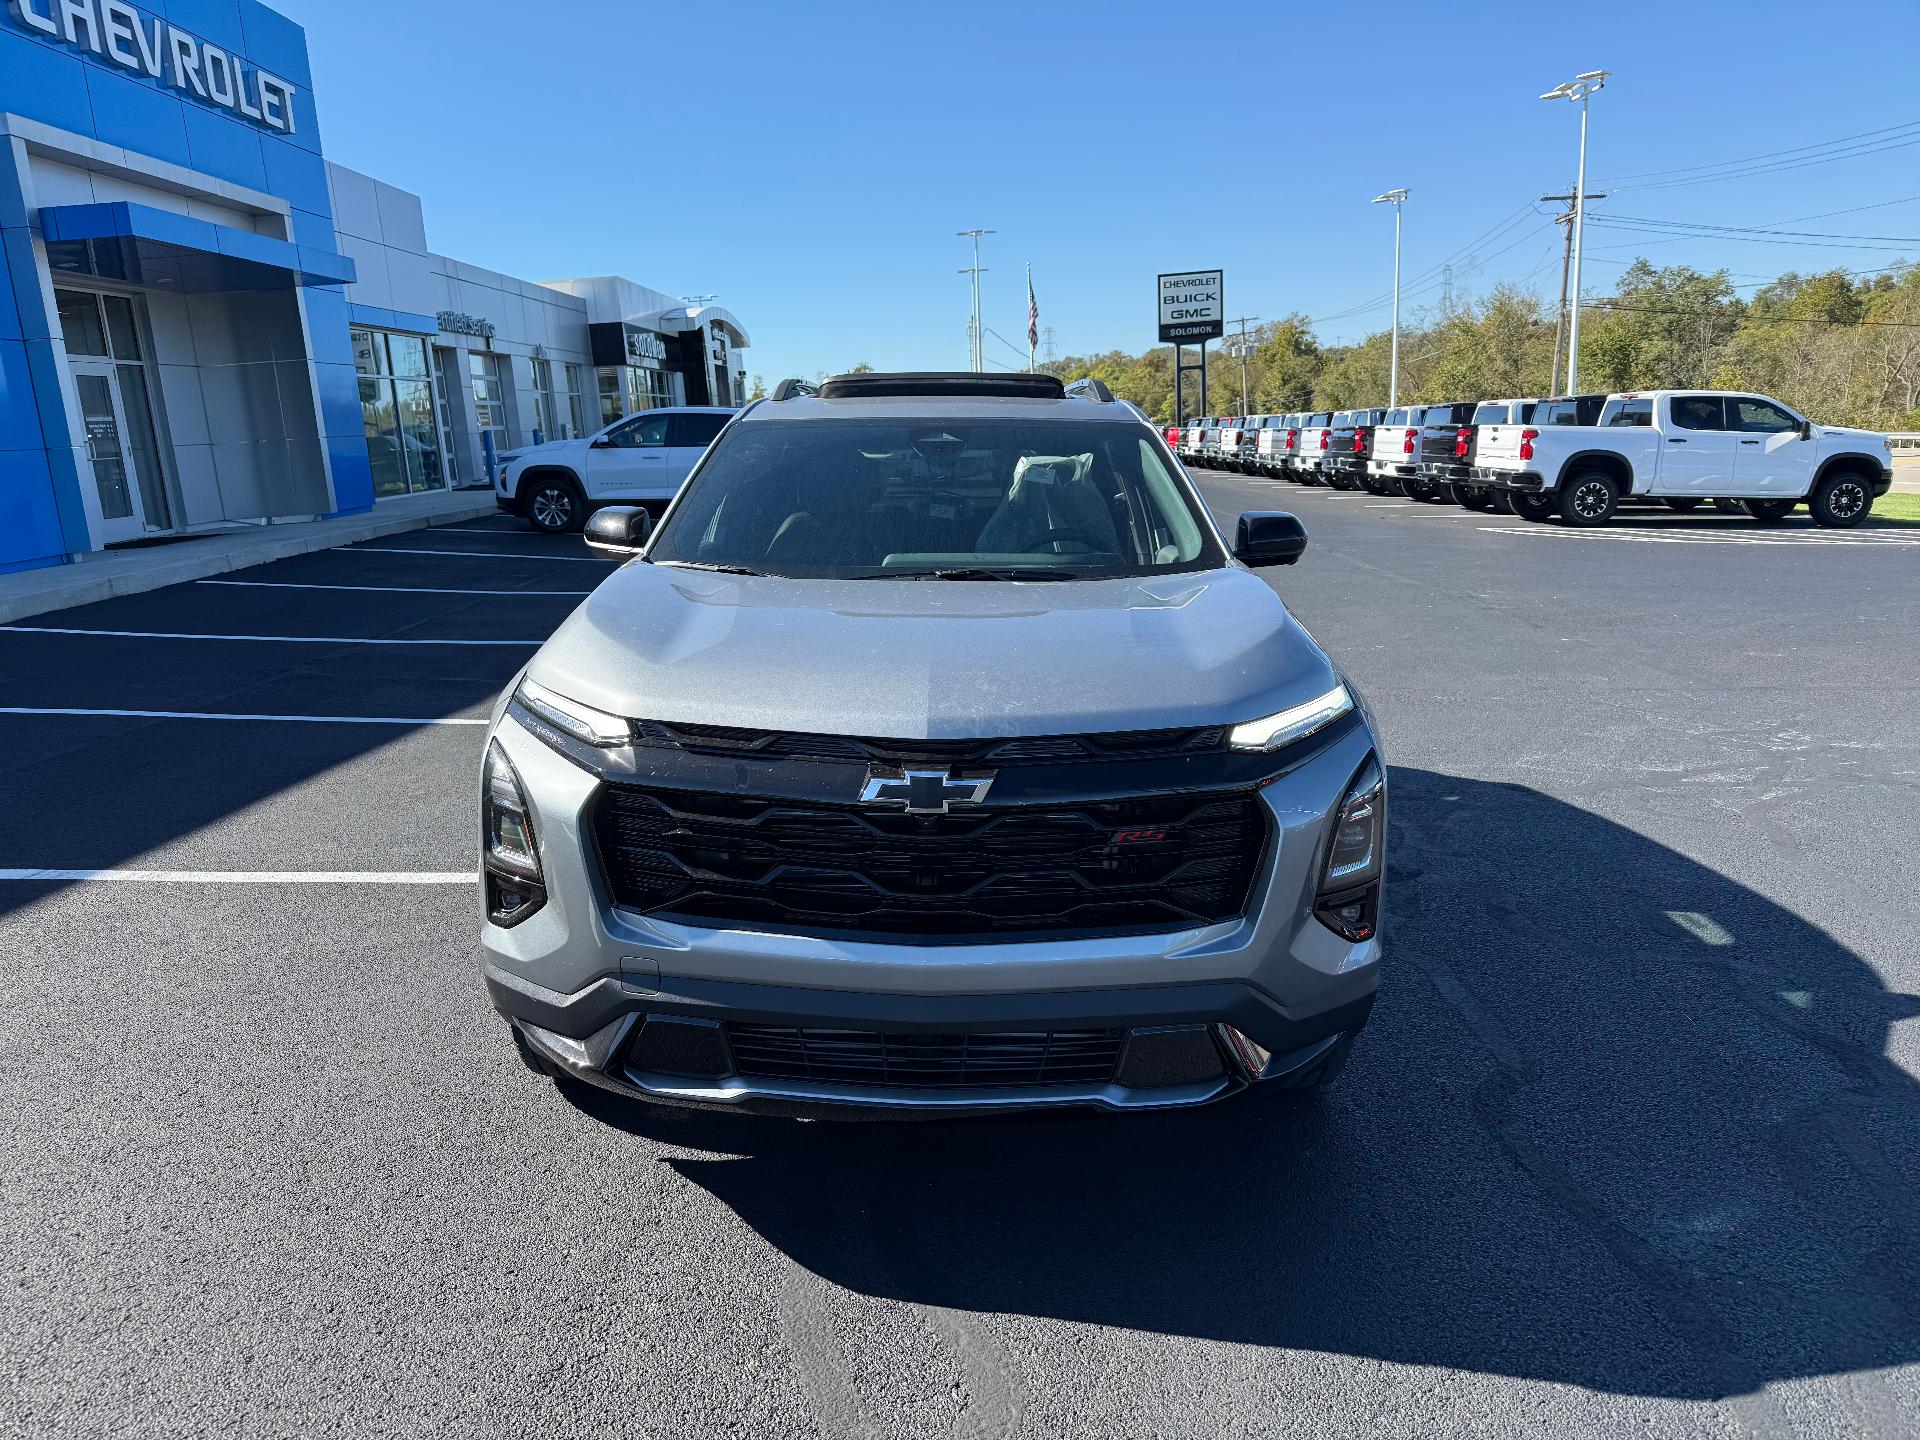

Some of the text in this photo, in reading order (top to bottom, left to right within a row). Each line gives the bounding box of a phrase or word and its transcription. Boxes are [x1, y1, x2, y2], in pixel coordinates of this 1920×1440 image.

[1163, 277, 1217, 289] CHEVROLET
[1163, 292, 1217, 305] BUICK
[1170, 307, 1211, 320] GMC
[1170, 325, 1212, 336] SOLOMON
[634, 334, 666, 360] SOLOMON
